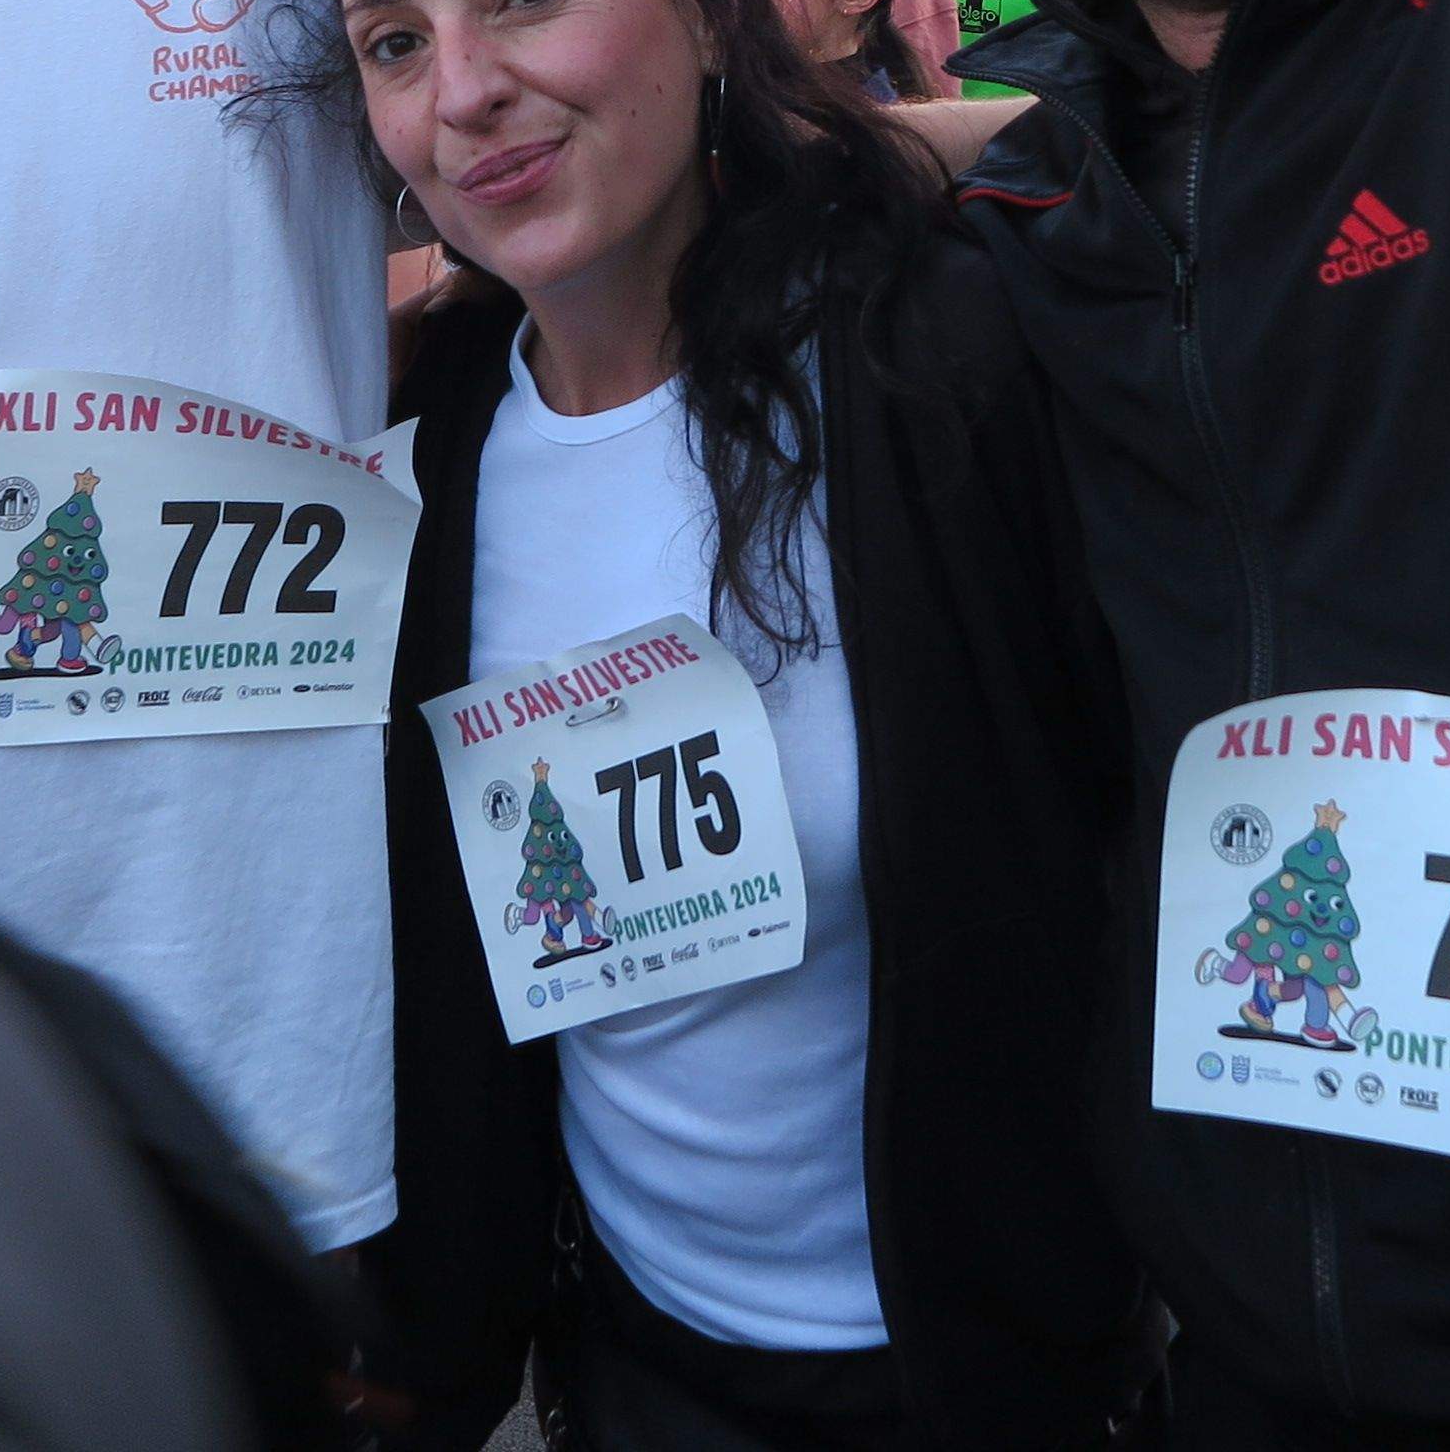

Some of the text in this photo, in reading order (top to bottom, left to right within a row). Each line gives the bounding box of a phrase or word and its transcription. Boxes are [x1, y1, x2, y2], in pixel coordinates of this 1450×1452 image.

[1318, 230, 1430, 286] adidas
[74, 392, 162, 432] SAN
[176, 401, 383, 477] SILVESTRE
[159, 501, 346, 618] 772
[109, 638, 355, 675] PONTEVEDRA 2024
[453, 633, 700, 747] XLI SAN SILVESTRE
[1218, 715, 1293, 760] XLI
[1311, 713, 1413, 764] SAN
[594, 729, 742, 884] 775
[613, 871, 782, 945] PONTEVEDRA 2024
